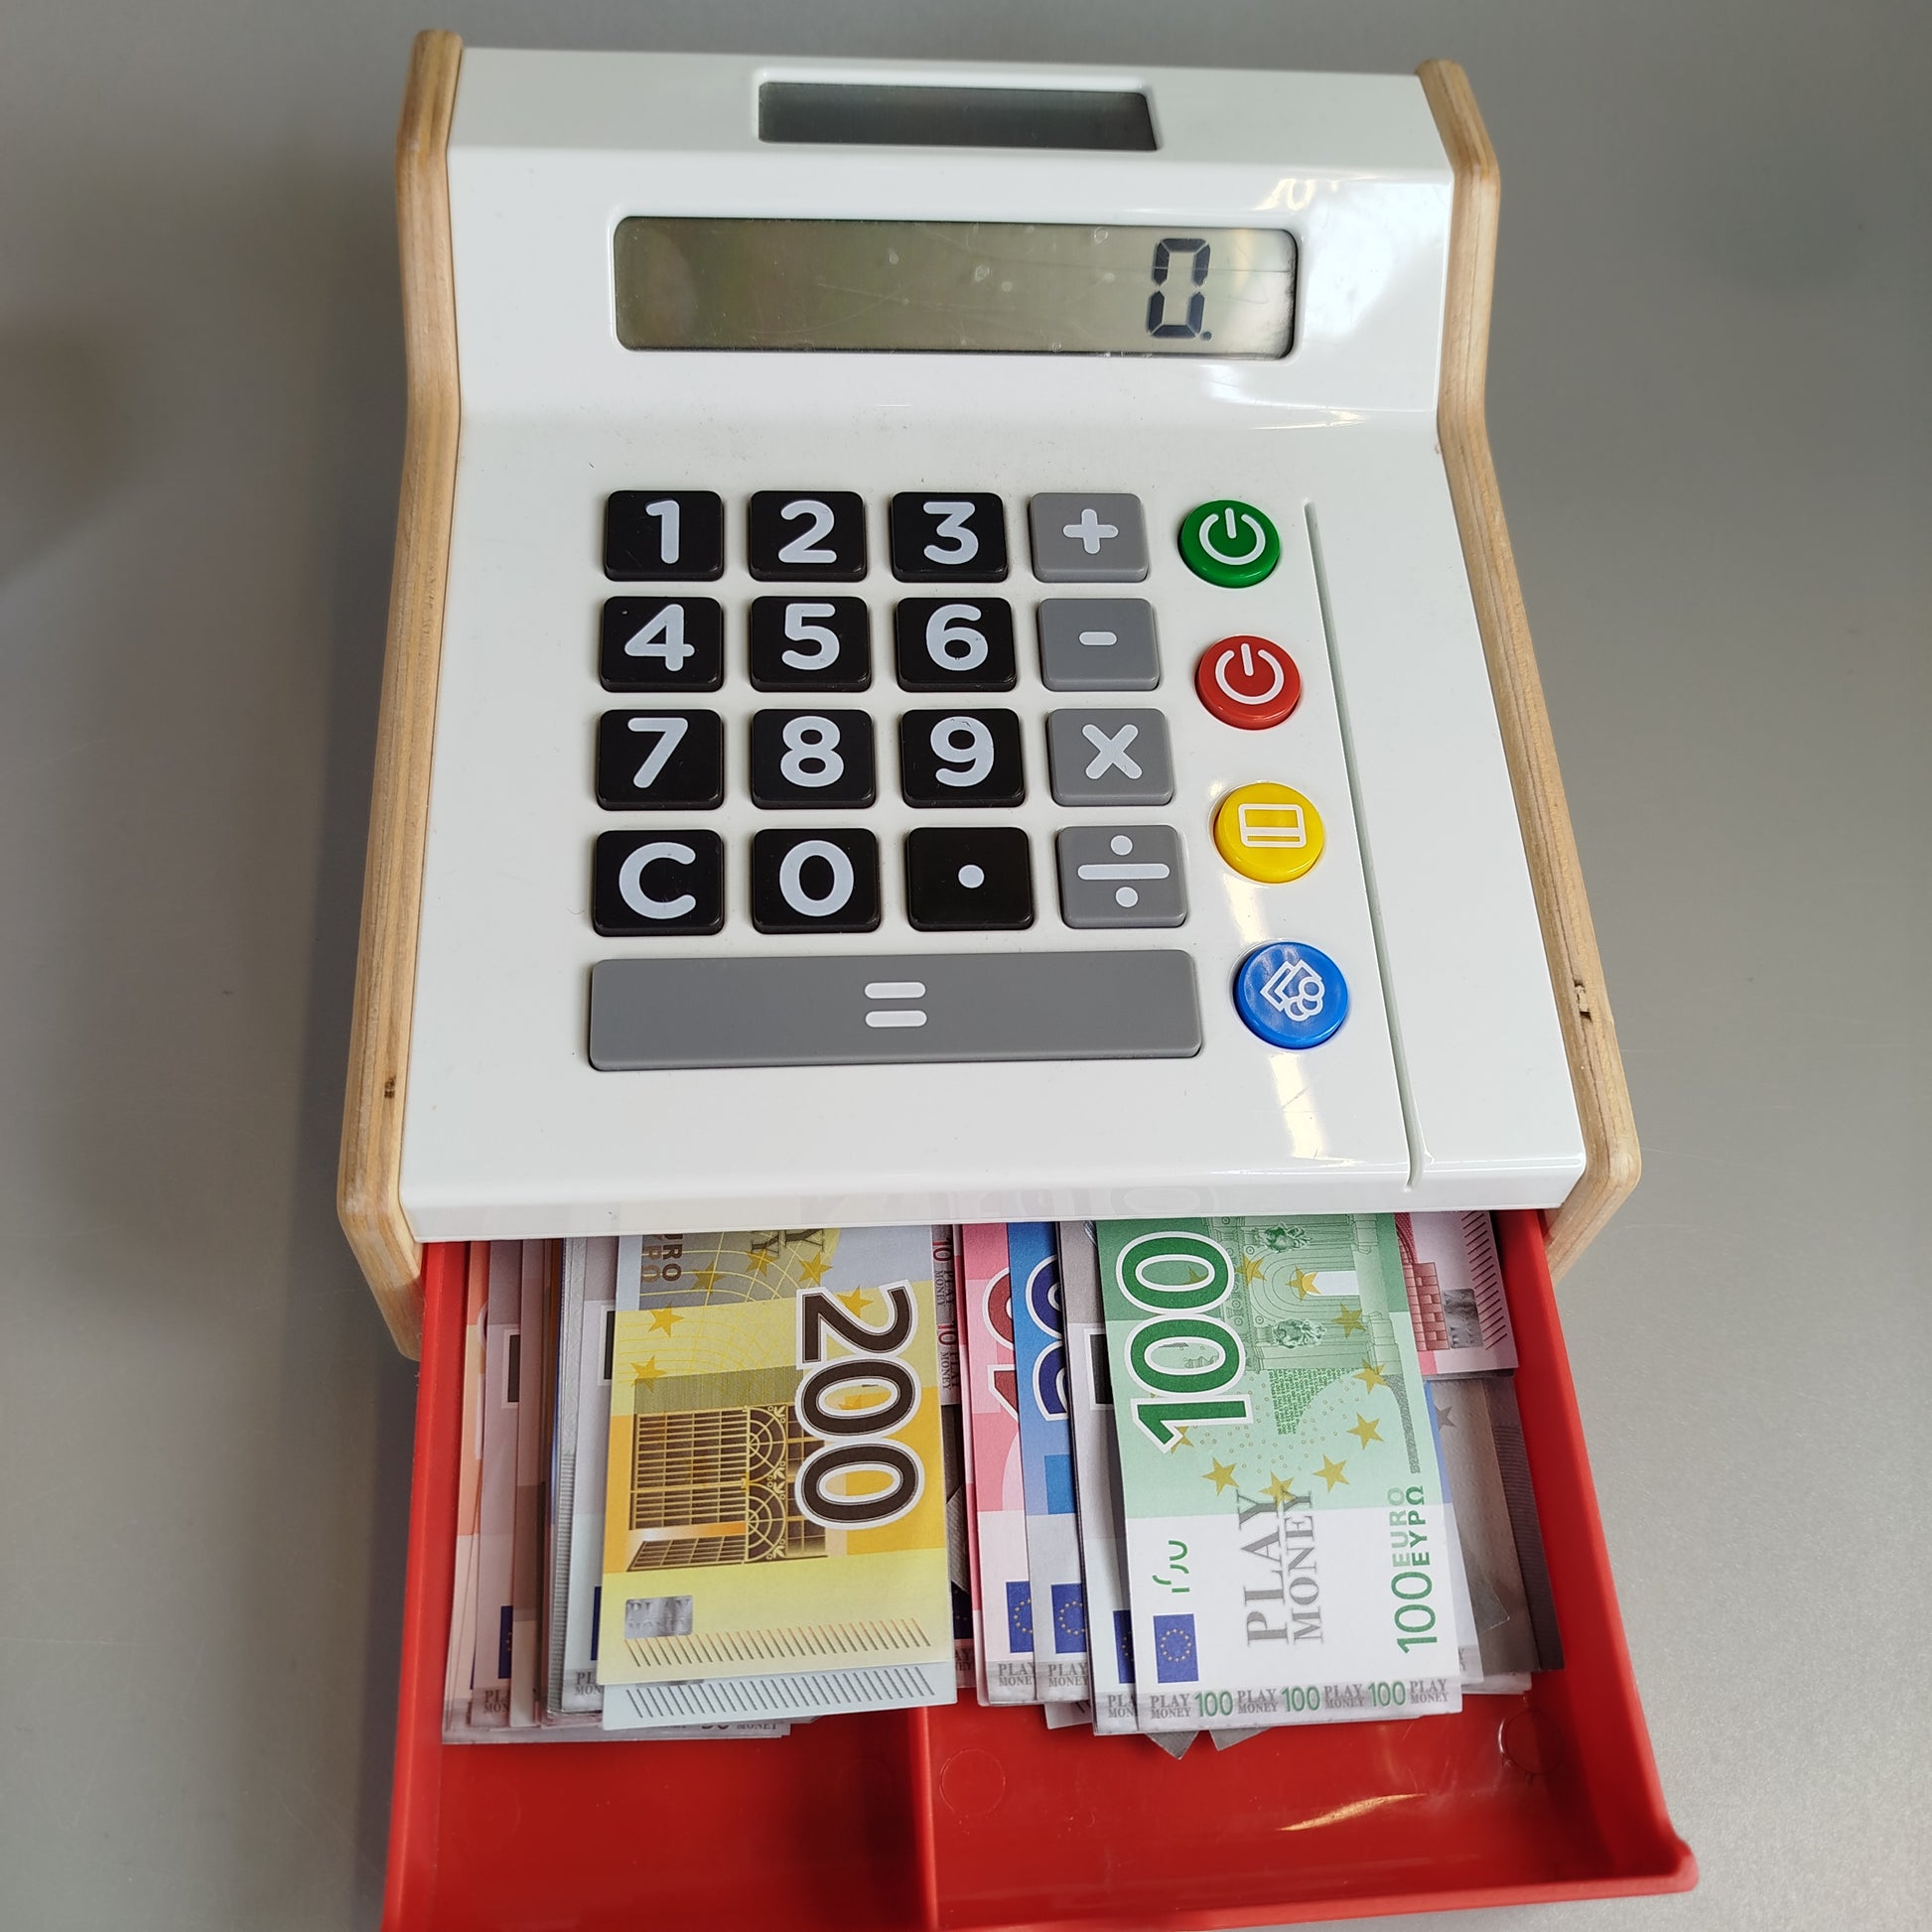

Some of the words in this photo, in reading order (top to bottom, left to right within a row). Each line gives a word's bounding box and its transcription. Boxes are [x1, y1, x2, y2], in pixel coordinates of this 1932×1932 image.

[645, 499, 681, 564] 1
[777, 499, 837, 564] 2
[922, 500, 979, 565] 3
[624, 604, 695, 671] 4
[781, 603, 841, 671] 5
[925, 604, 989, 671] 6
[627, 717, 689, 788] 7
[780, 715, 844, 787] 8
[930, 716, 995, 787] 9
[619, 841, 696, 919] C
[779, 840, 854, 917] 0
[1116, 1231, 1253, 1452] 100
[796, 1281, 924, 1530] 200
[1387, 1486, 1411, 1567] EURO
[1236, 1489, 1290, 1647] PLAY
[1281, 1489, 1324, 1646] MONEY
[1391, 1572, 1438, 1654] 100
[1048, 1662, 1089, 1677] PLAY
[1150, 1693, 1191, 1709] PLAY
[1194, 1690, 1234, 1718] 100
[1237, 1689, 1278, 1704] PLAY
[1281, 1686, 1320, 1713] 100
[1324, 1683, 1363, 1700] PLAY
[1368, 1681, 1406, 1708] 100
[1409, 1679, 1449, 1694] PLAY
[1151, 1707, 1191, 1719] MONEY
[1237, 1702, 1279, 1715] MONEY
[1324, 1697, 1366, 1710] MONEY
[1410, 1691, 1449, 1705] MONEY
